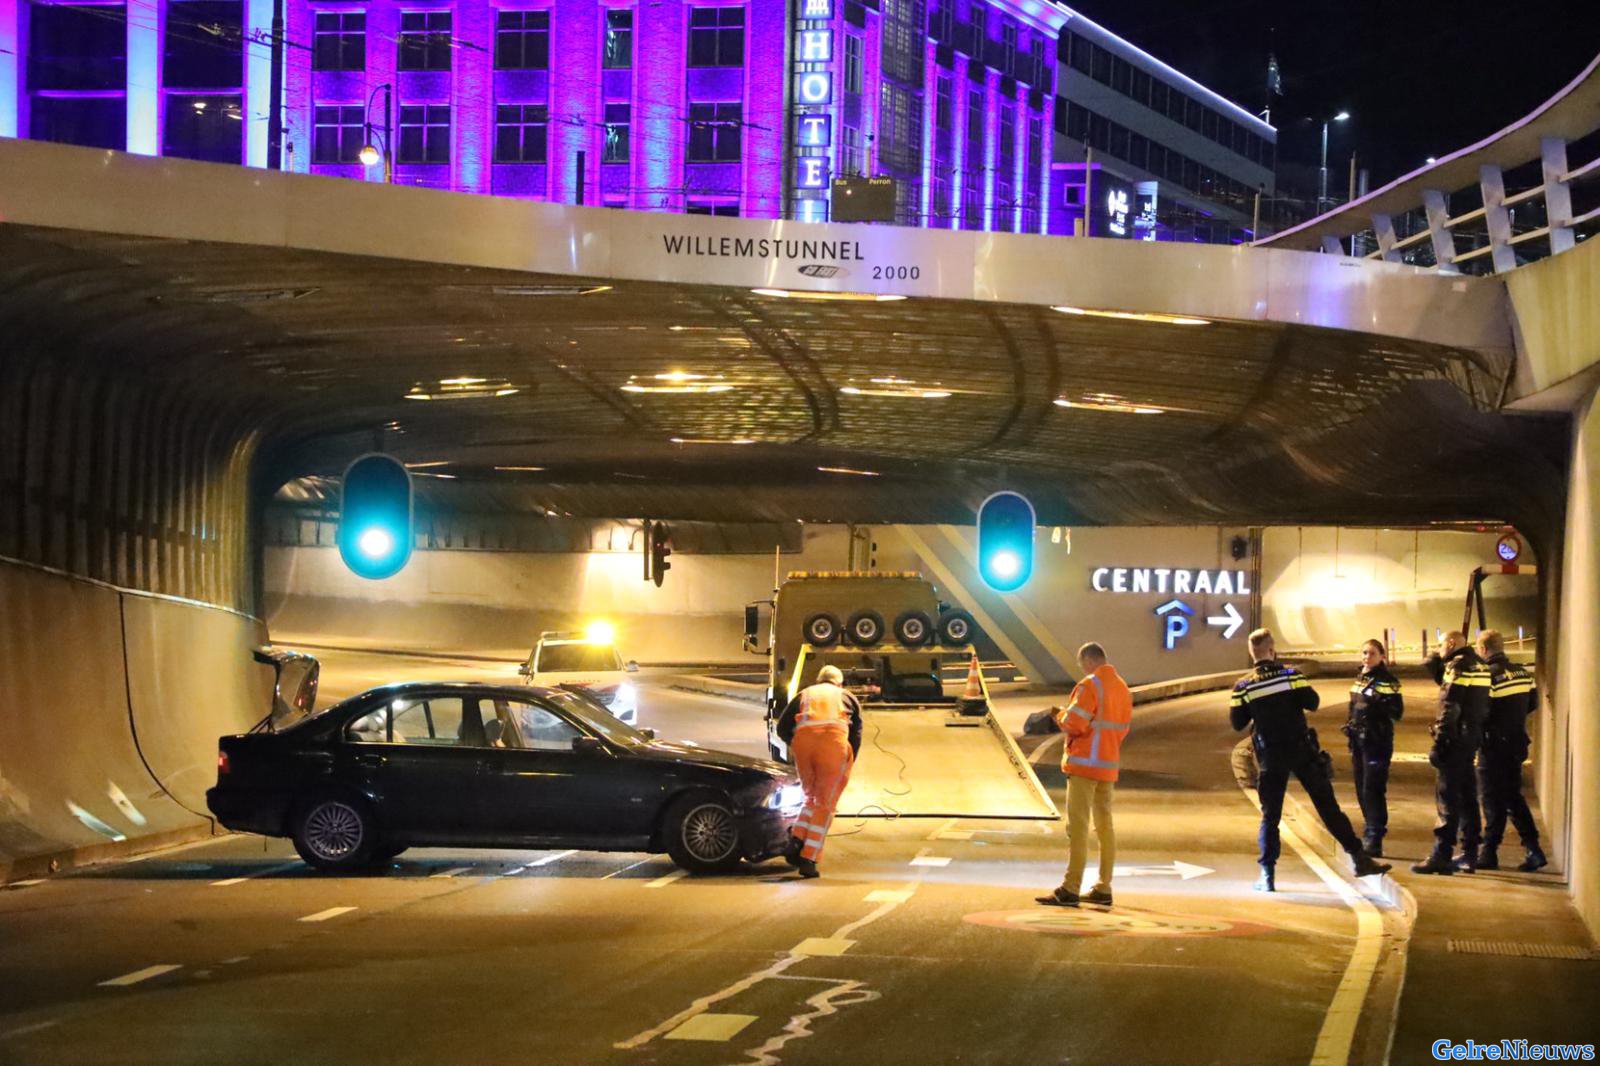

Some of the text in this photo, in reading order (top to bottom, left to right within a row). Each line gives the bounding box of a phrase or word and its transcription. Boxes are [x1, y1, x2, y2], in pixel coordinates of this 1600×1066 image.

[802, 31, 830, 223] HOTEL
[663, 234, 864, 260] WILLEMSTUNNEL
[872, 265, 920, 280] 2000
[1092, 567, 1250, 595] CENTRAAL
[1166, 615, 1189, 649] P
